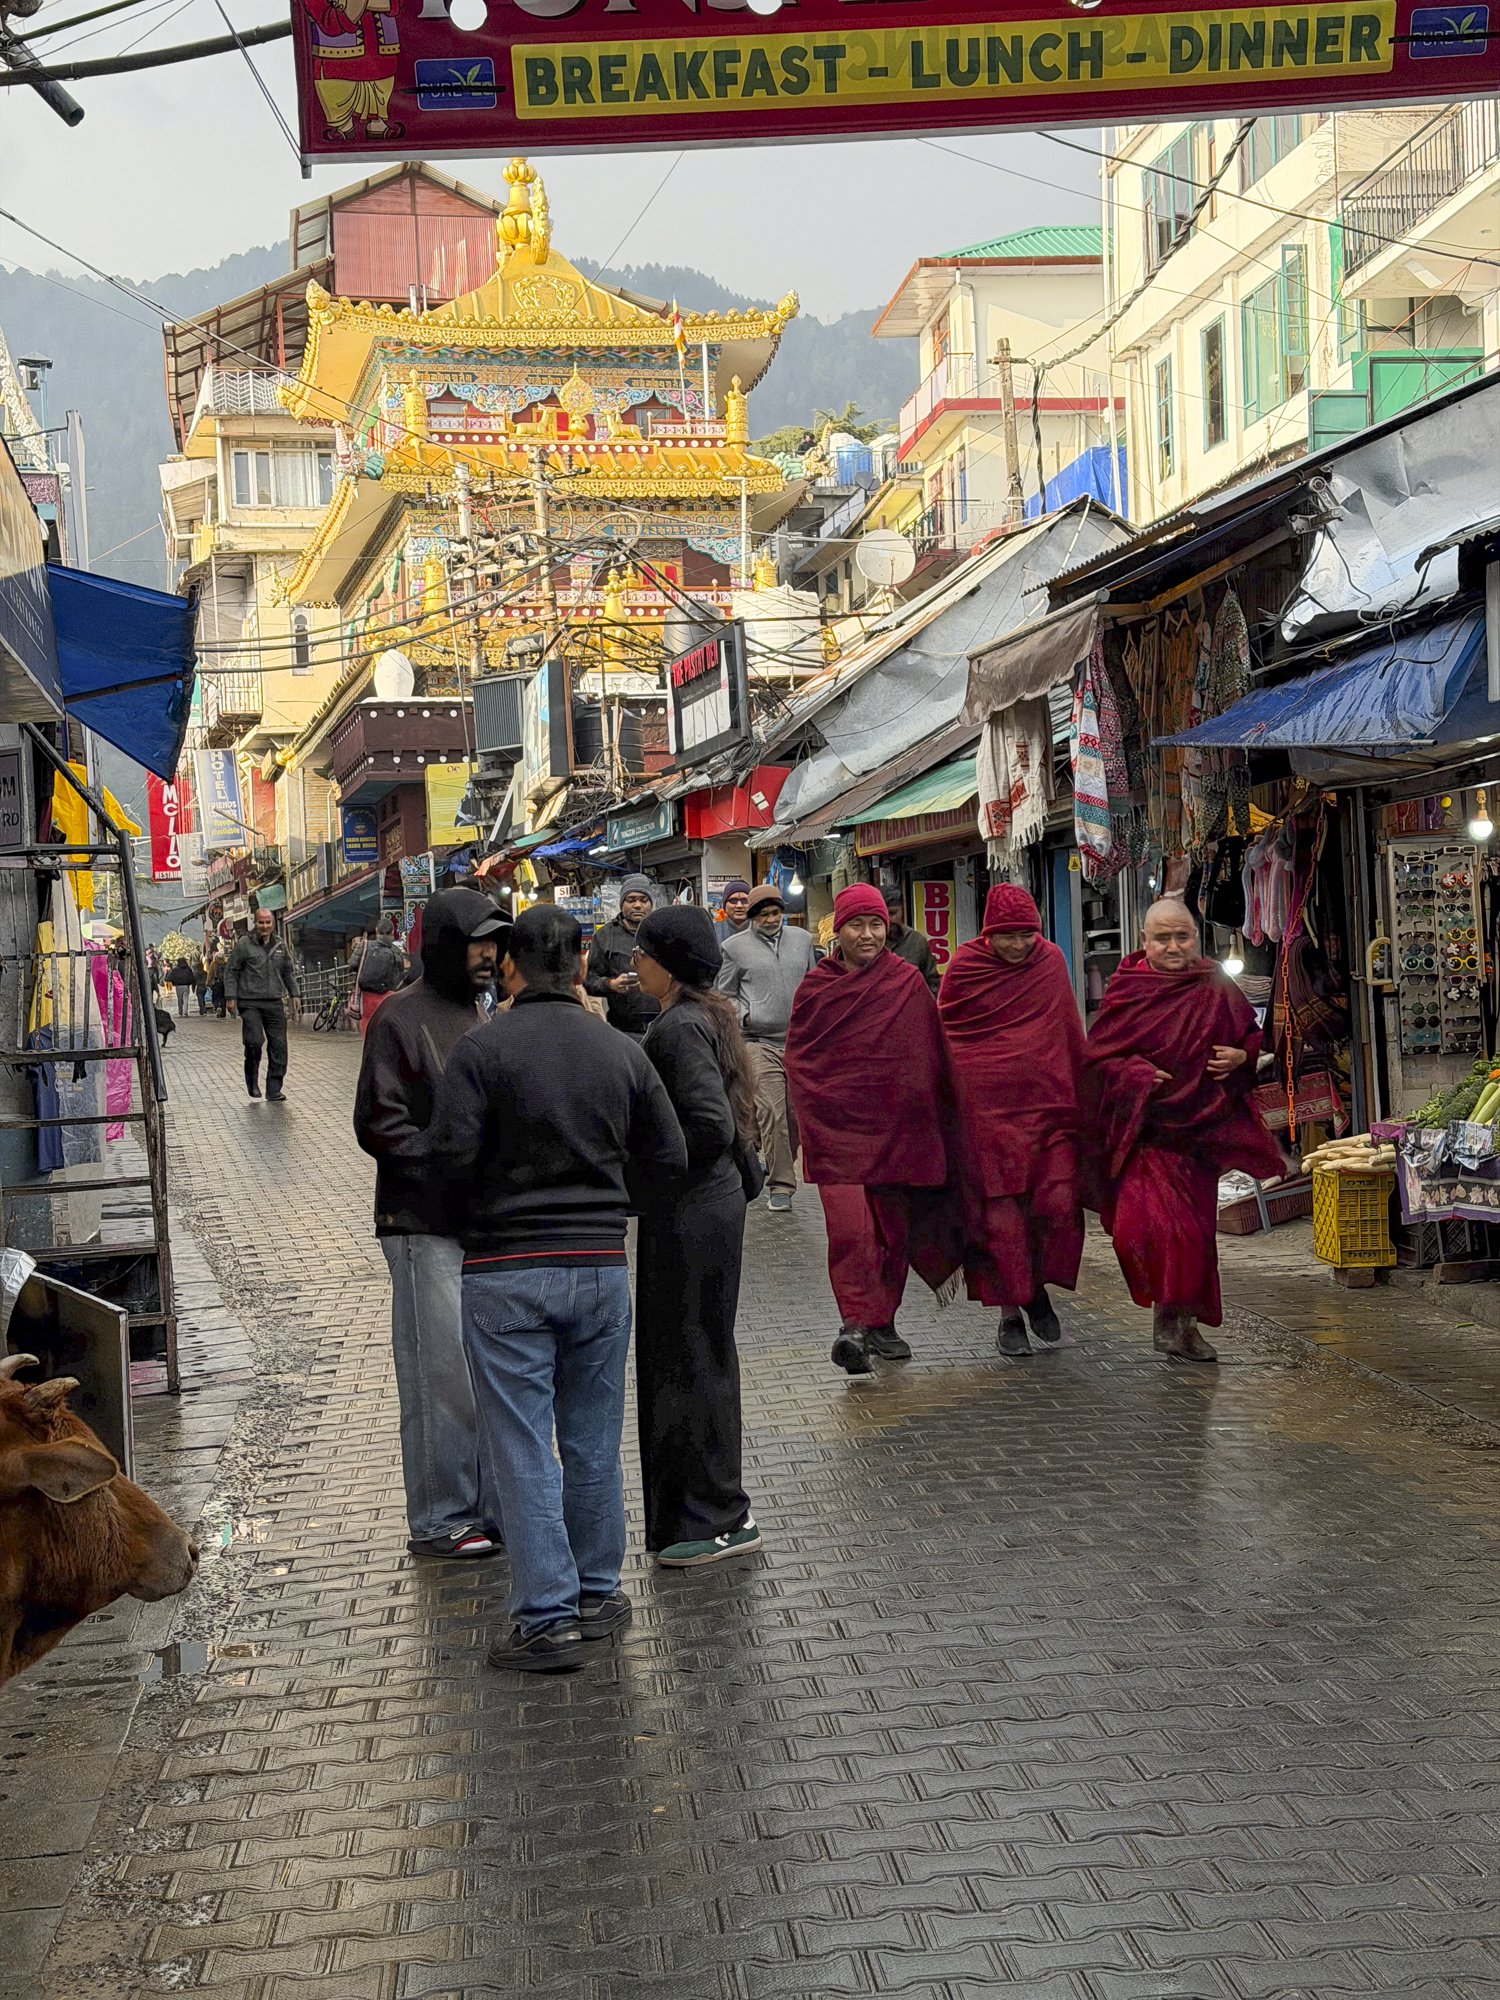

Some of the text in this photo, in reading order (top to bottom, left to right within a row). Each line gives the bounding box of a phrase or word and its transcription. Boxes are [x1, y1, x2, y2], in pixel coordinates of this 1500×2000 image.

[525, 44, 847, 106] BREAKFAST
[911, 30, 1103, 89] LUNCH
[1169, 14, 1382, 74] DINNER
[672, 639, 719, 688] THE PASTRY DEN
[211, 751, 227, 800] HOTEL
[560, 886, 578, 896] SIM
[924, 882, 951, 965] BUS
